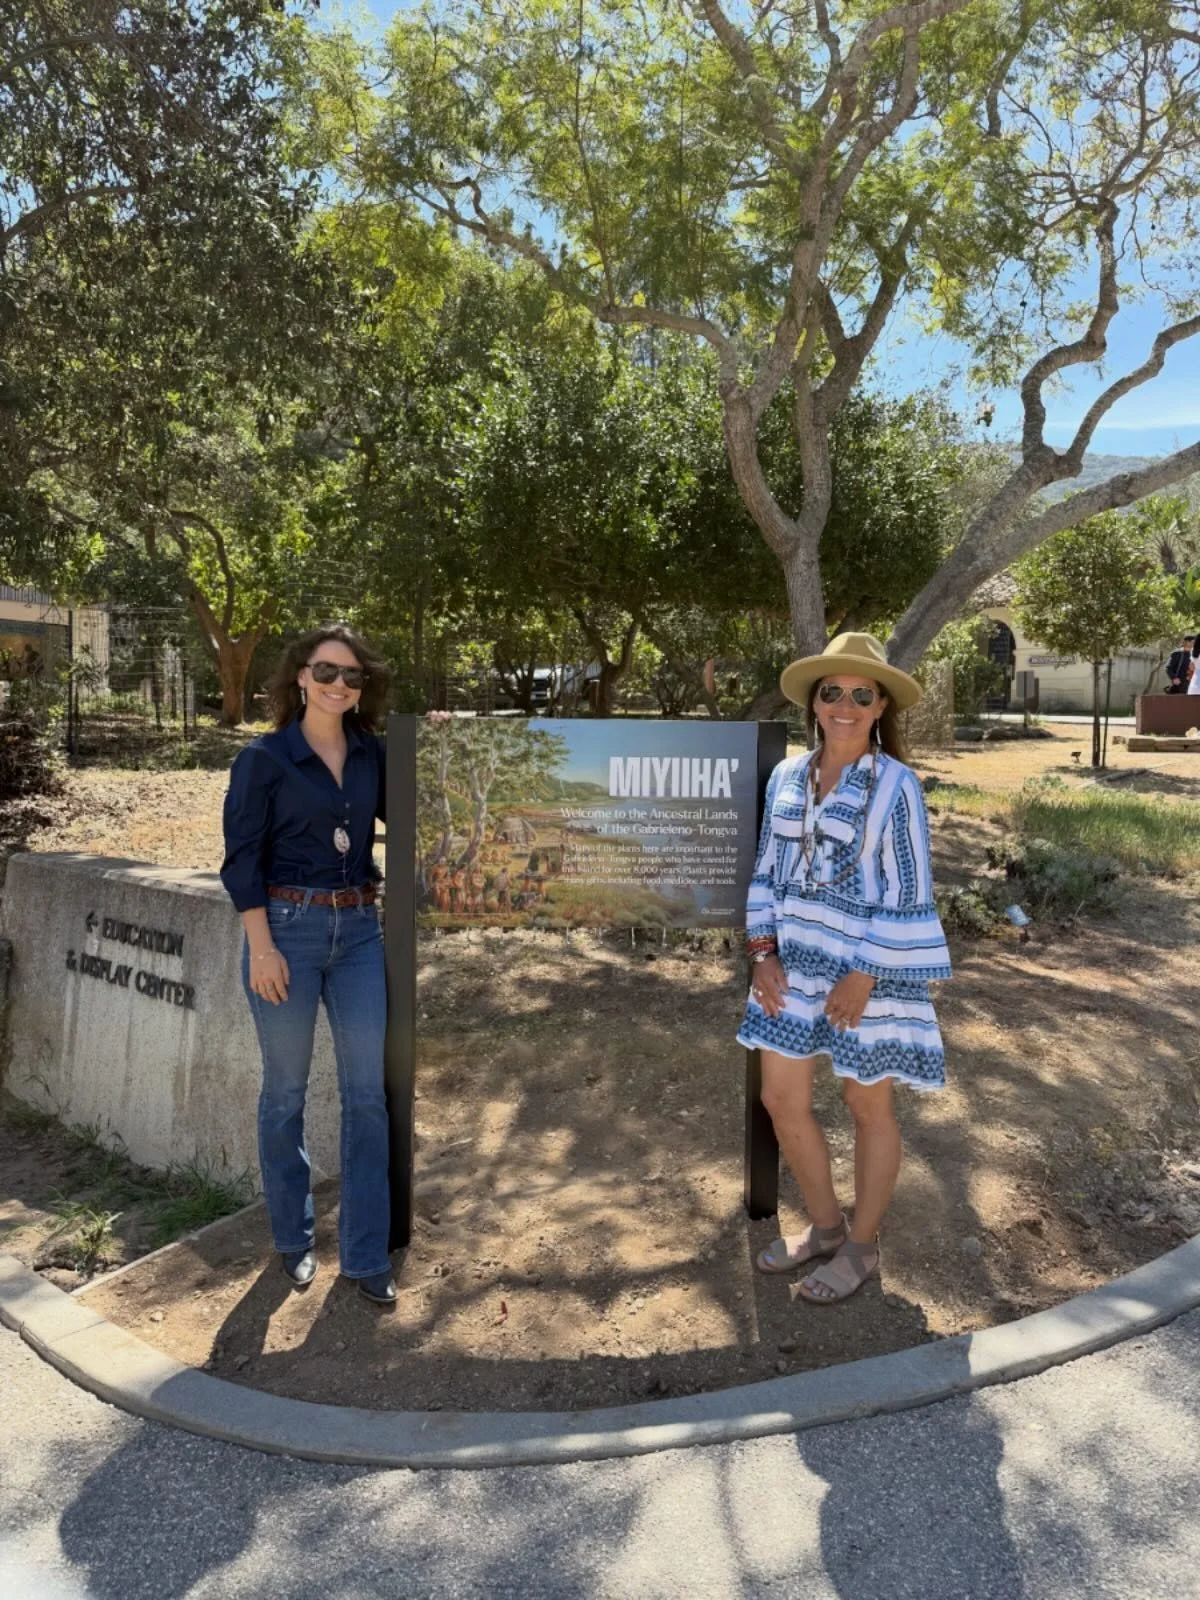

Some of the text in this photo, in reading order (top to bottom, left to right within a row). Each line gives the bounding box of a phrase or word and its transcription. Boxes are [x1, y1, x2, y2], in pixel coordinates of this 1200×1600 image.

[560, 807, 738, 820] Welcome to the Ancestral Lands
[597, 823, 608, 834] of
[611, 823, 630, 835] the
[603, 843, 616, 852] the
[618, 844, 640, 854] plants
[642, 844, 659, 854] here
[661, 845, 674, 854] are
[675, 845, 713, 855] important
[715, 845, 724, 854] to
[725, 844, 738, 854] the
[638, 855, 663, 865] people
[665, 856, 681, 864] who
[682, 855, 700, 864] have
[702, 856, 725, 864] cared
[725, 855, 738, 864] for
[683, 866, 708, 876] Plants
[709, 867, 737, 877] provide
[699, 877, 714, 885] and
[716, 876, 737, 885] tools.
[102, 918, 184, 957] EDUCATION
[80, 953, 133, 987] DISPLAY
[135, 970, 195, 1010] CENTER
